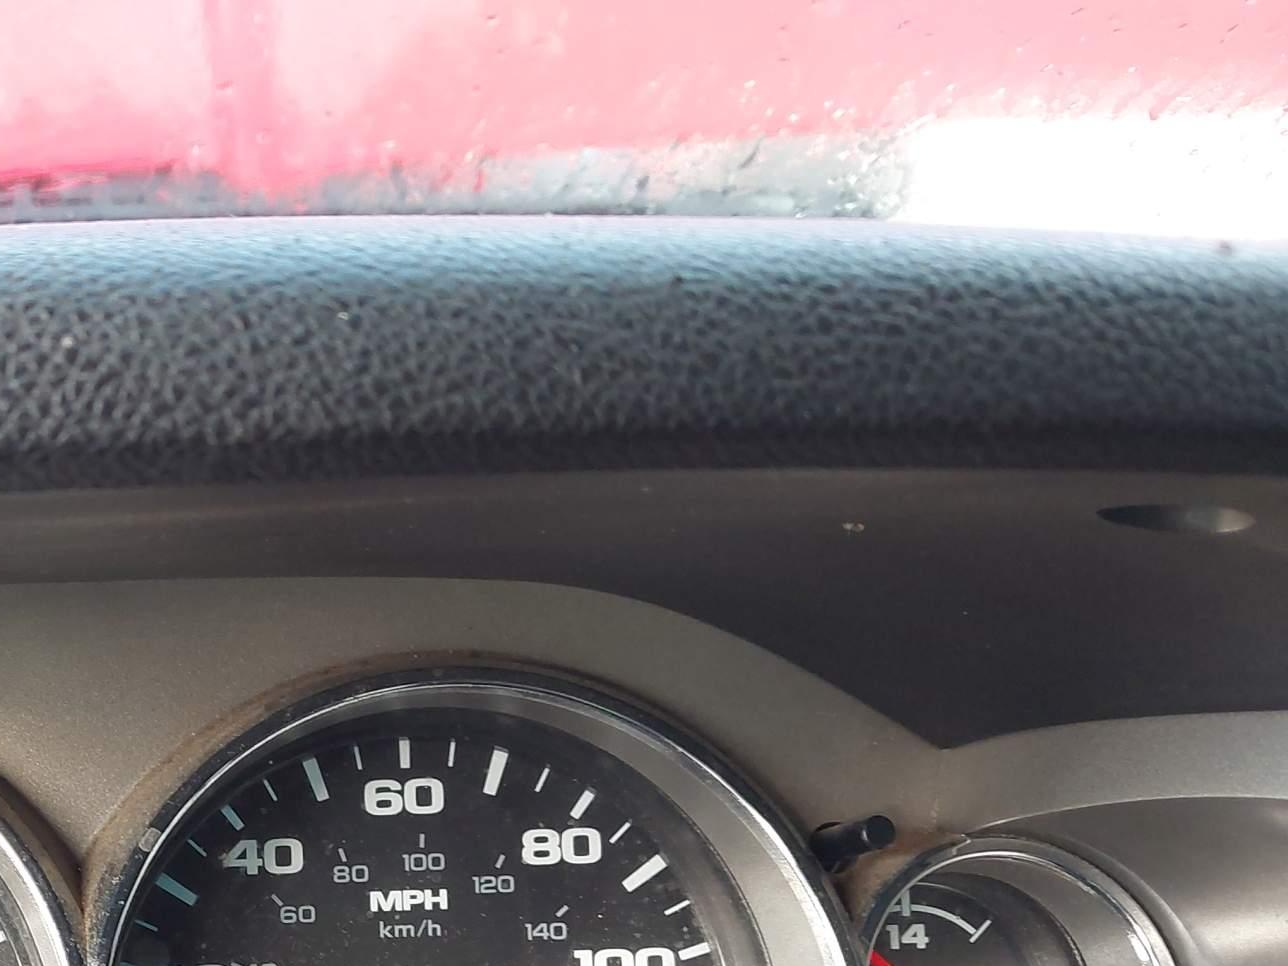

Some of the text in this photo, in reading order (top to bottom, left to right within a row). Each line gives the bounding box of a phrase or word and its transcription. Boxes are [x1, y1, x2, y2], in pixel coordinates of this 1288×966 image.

[364, 778, 444, 815] 60
[522, 828, 601, 865] 80
[224, 838, 303, 874] 40
[402, 853, 445, 871] 100
[334, 865, 368, 882] 80
[472, 876, 514, 893] 120
[370, 889, 448, 911] MPH
[280, 906, 315, 923] 60
[380, 920, 441, 938] km/h
[525, 923, 567, 940] 140
[887, 924, 929, 949] 14
